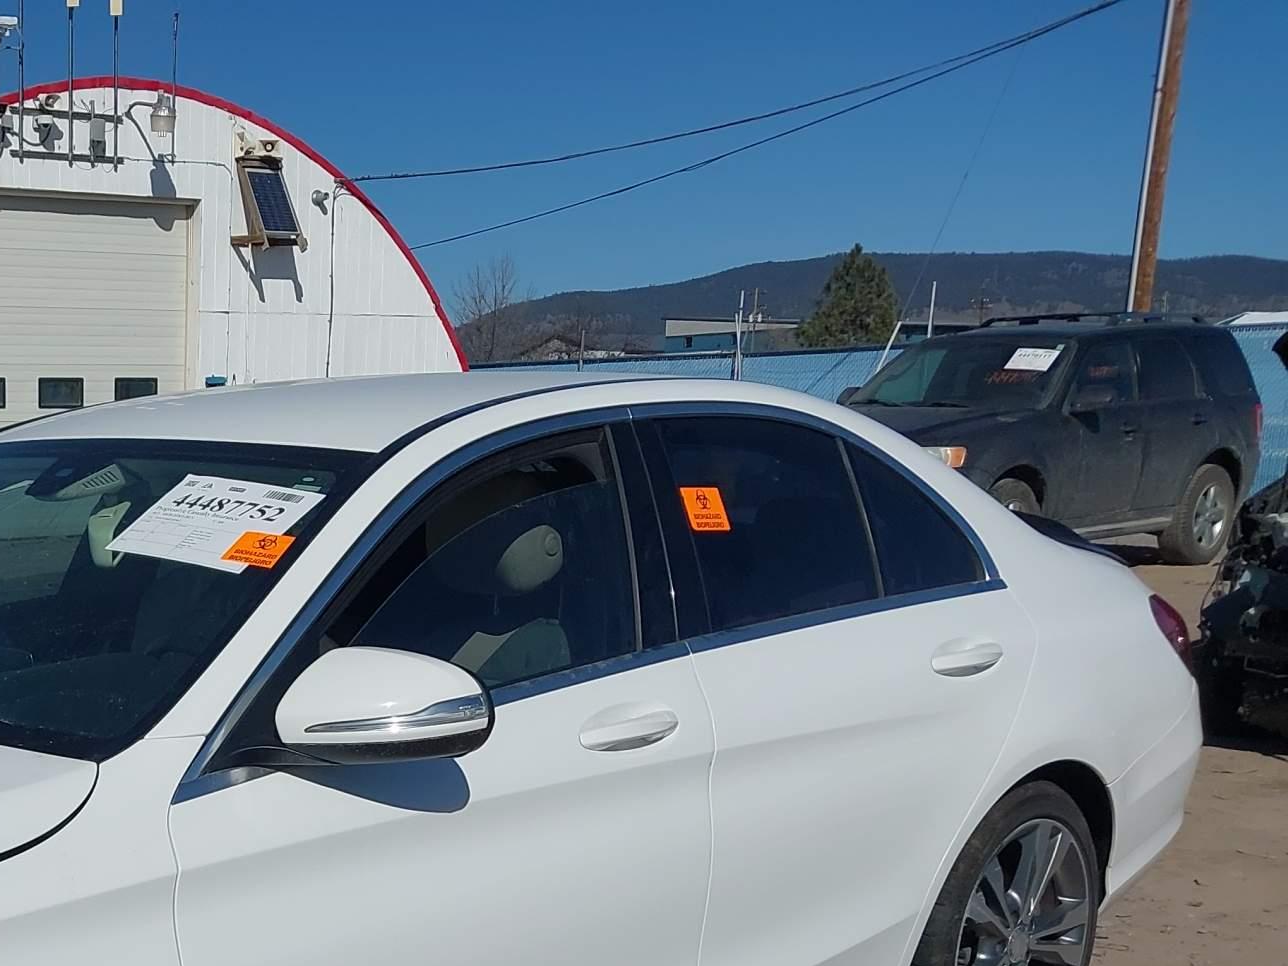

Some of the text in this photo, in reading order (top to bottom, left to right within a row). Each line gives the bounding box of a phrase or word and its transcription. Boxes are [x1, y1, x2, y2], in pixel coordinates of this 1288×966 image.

[172, 493, 285, 522] 44487752
[233, 549, 277, 559] BIOHAZARD
[229, 555, 272, 565] BIOPELIGRO
